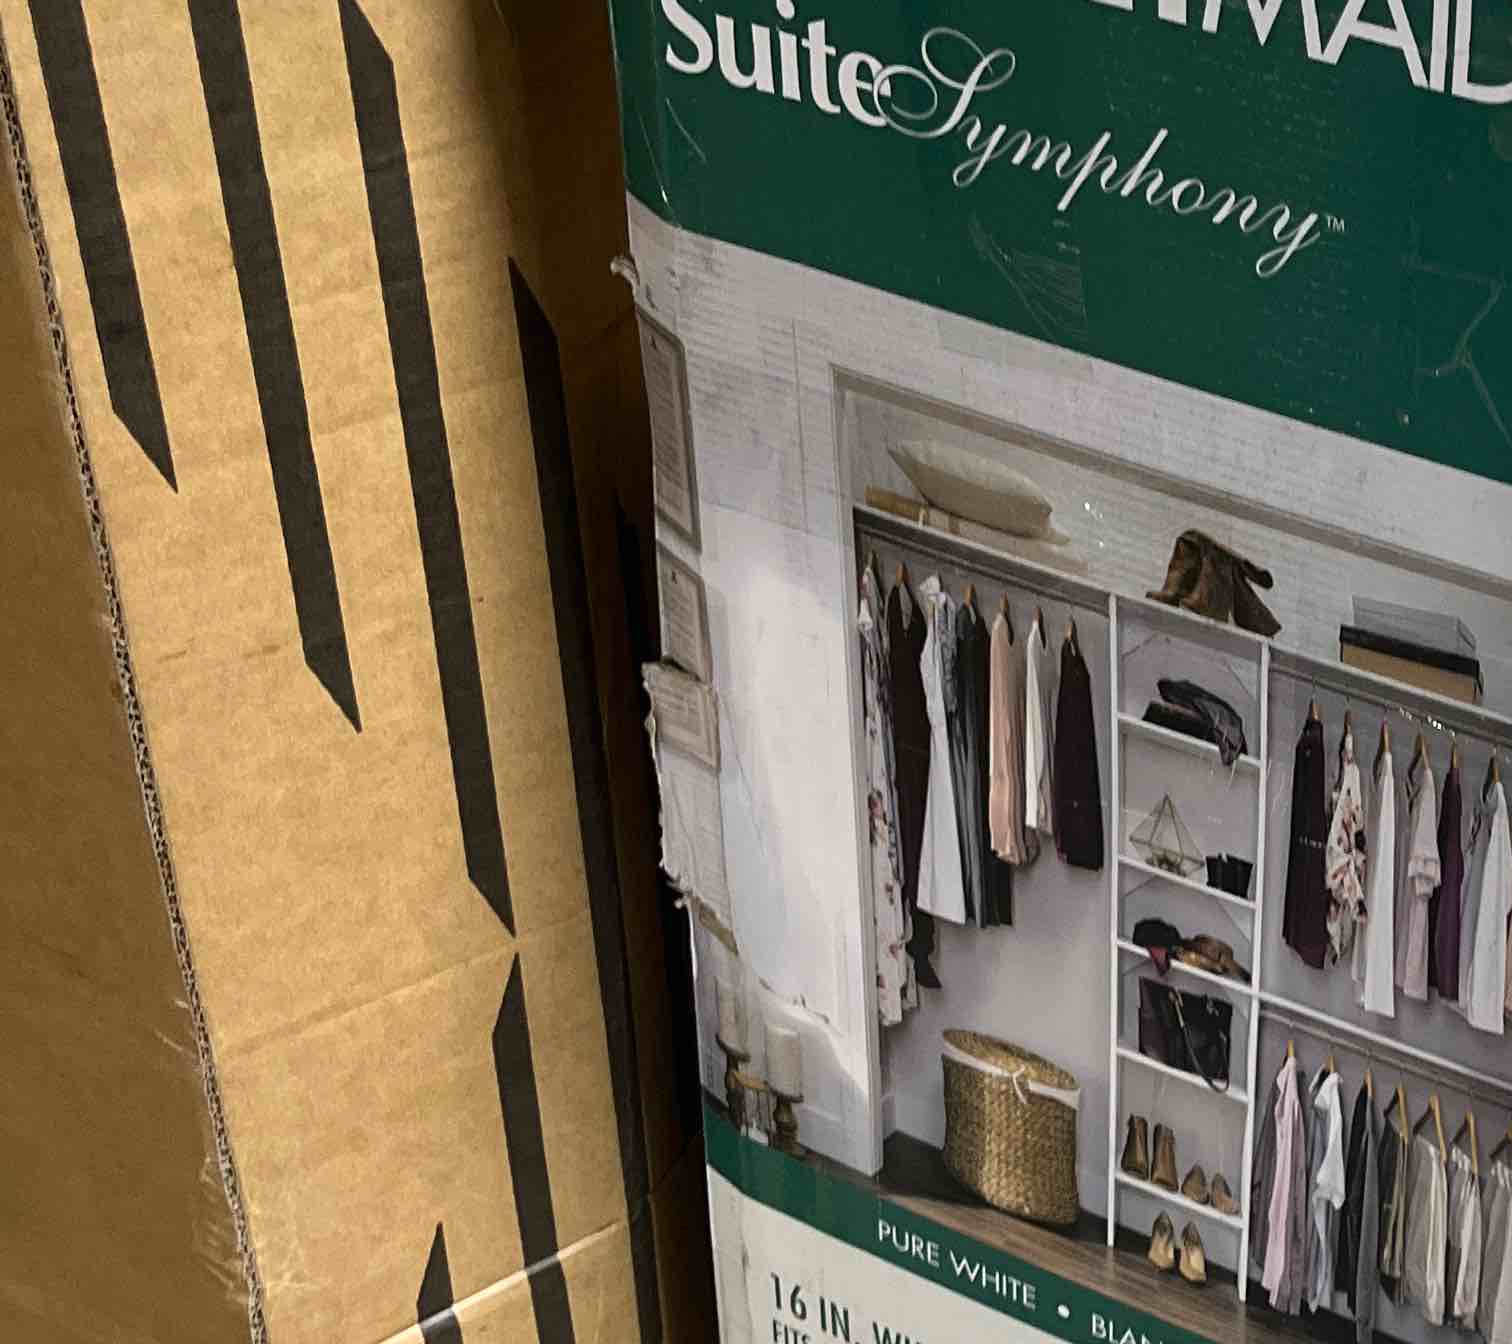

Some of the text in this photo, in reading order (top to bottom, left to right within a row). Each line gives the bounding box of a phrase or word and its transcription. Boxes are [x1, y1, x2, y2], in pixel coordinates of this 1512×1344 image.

[770, 1271, 809, 1321] 16
[878, 1218, 940, 1267] PURE
[949, 1249, 1038, 1310] WHITE
